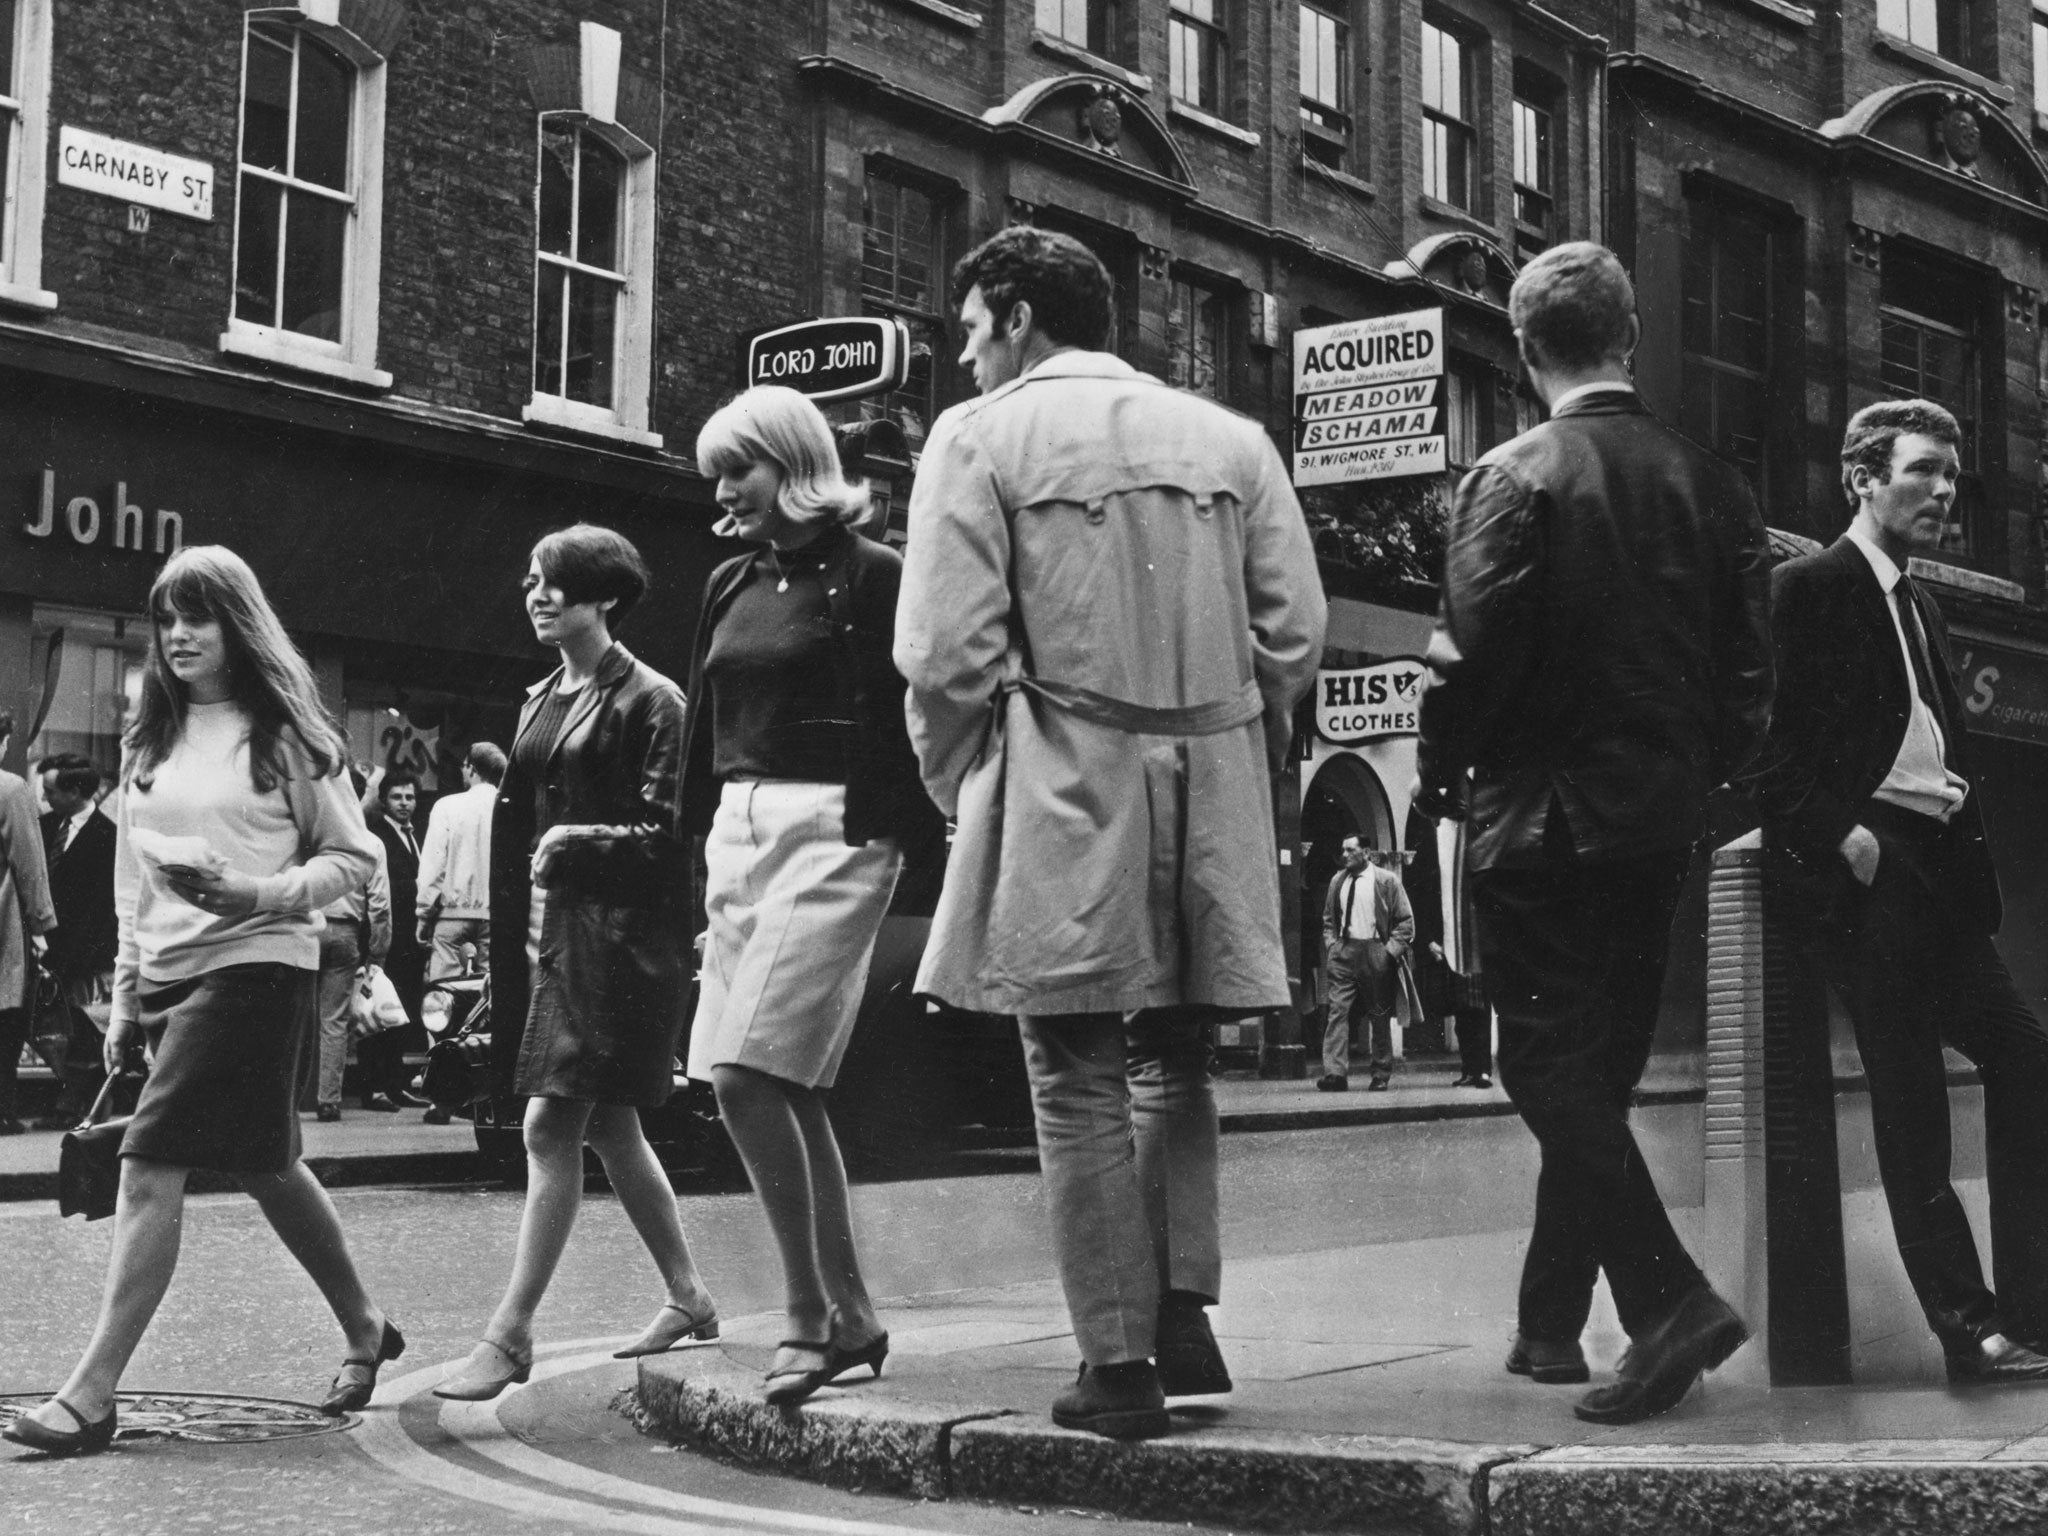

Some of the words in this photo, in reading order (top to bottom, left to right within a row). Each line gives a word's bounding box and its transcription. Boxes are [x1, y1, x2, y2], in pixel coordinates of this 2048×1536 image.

[65, 146, 169, 190] CARNABY
[757, 348, 815, 378] LORD
[1303, 329, 1434, 376] ACQUIRED
[1307, 384, 1427, 417] MEADOW
[1308, 412, 1426, 444] SCHAMA
[1320, 447, 1387, 466] WIGMORE
[24, 469, 183, 554] John
[1324, 674, 1388, 707] HIS
[1328, 712, 1416, 732] CLOTHES
